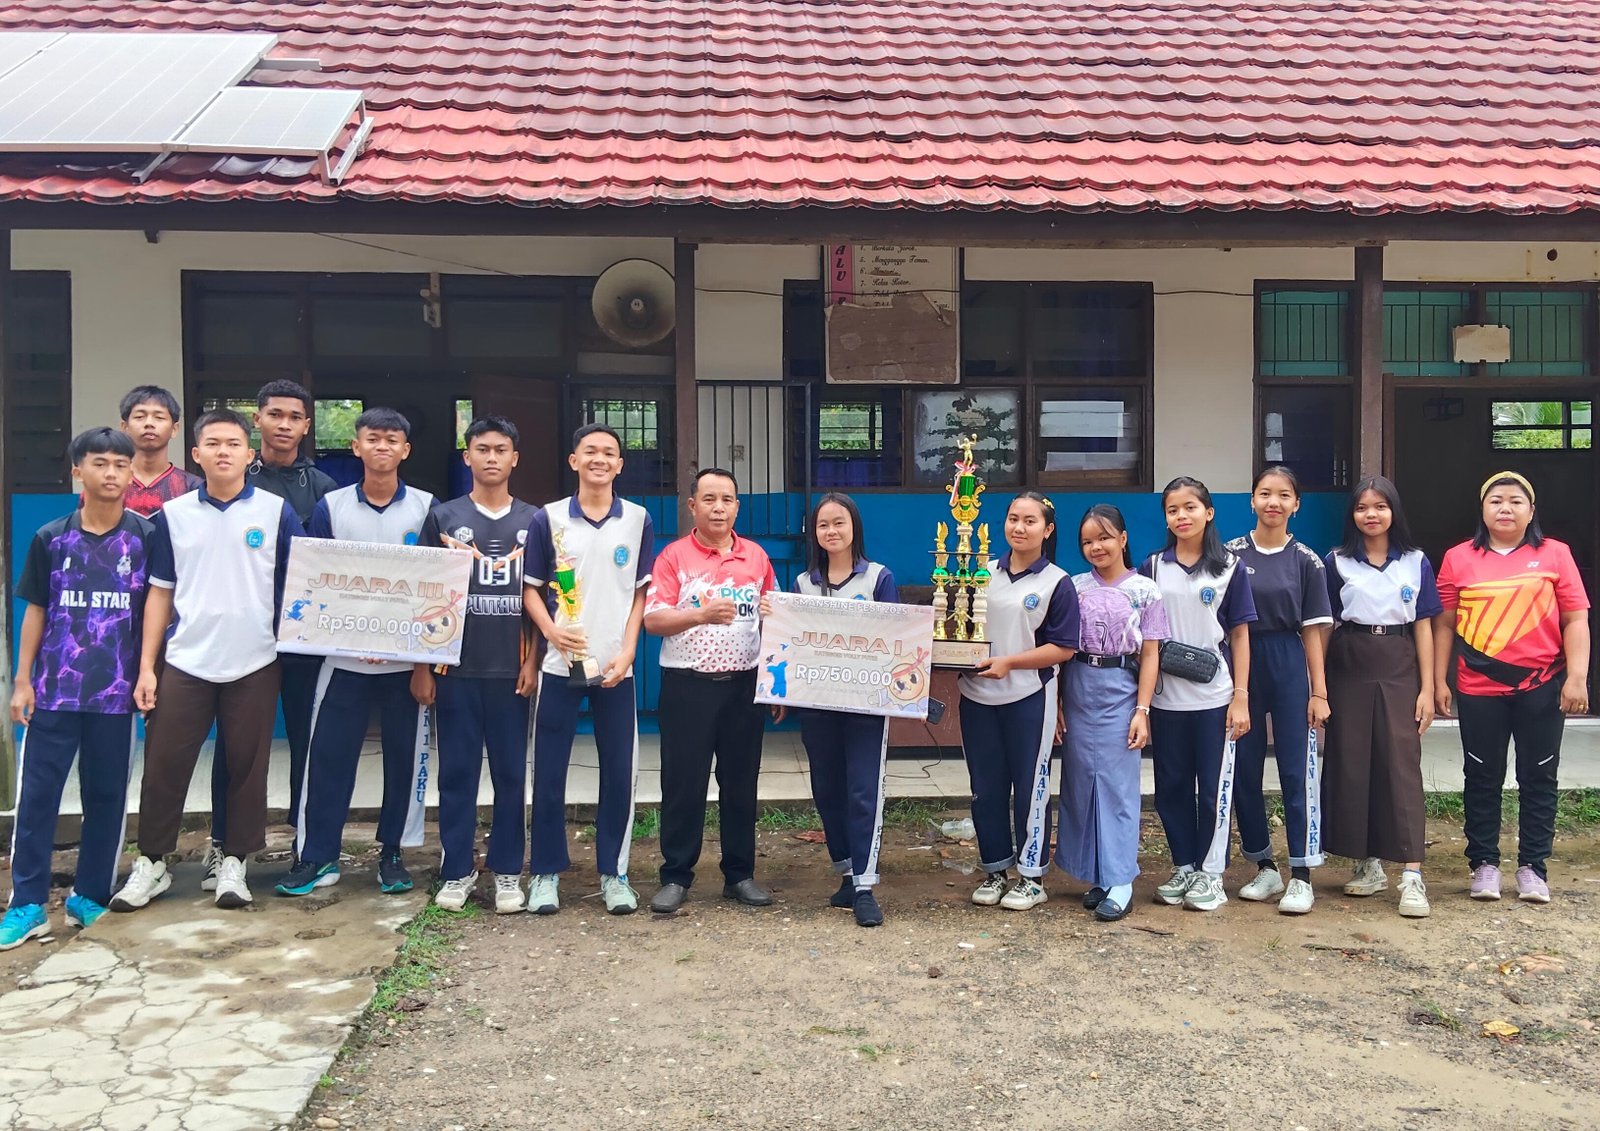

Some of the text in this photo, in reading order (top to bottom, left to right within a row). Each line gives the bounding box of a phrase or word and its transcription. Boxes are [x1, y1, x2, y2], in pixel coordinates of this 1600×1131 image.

[478, 556, 511, 586] 03
[308, 573, 445, 599] JUARA III
[720, 587, 754, 603] PKG
[59, 590, 131, 610] ALL STAR
[791, 597, 855, 612] SMANSHINE
[316, 612, 424, 636] Rp500.000
[791, 631, 903, 656] JUARA I
[795, 663, 893, 687] Rp750.000
[1308, 728, 1316, 780] SMAN
[416, 752, 430, 803] PAKU
[1308, 806, 1318, 856] PAKU
